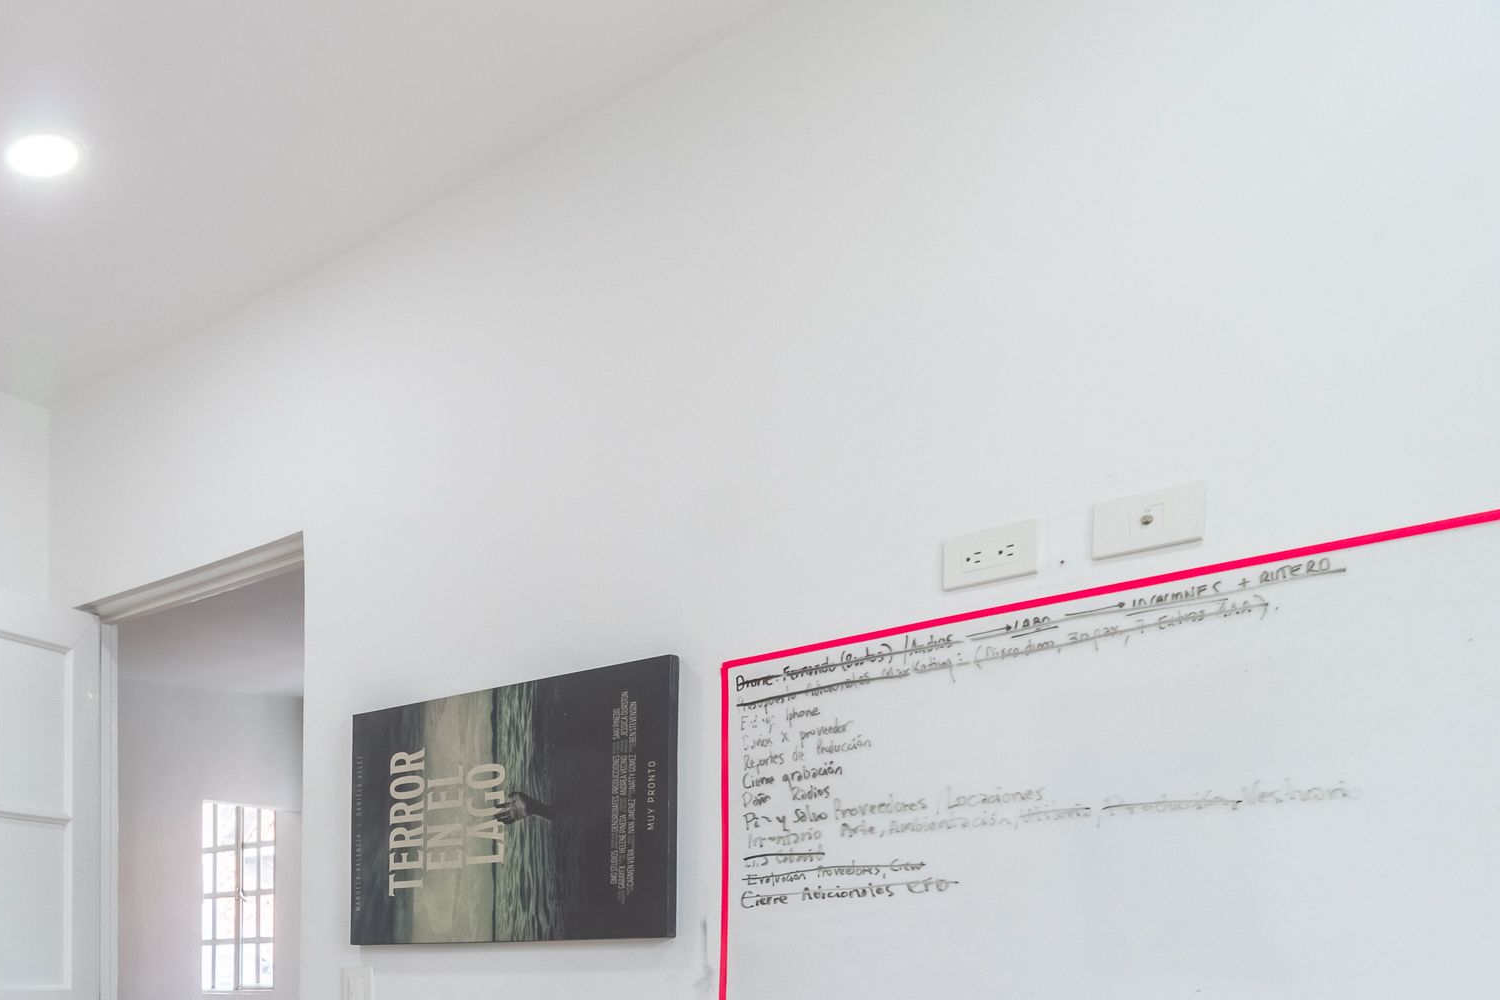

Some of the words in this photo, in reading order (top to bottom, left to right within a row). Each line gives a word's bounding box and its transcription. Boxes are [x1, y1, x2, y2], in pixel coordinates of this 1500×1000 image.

[1258, 557, 1330, 585] RUTERO
[743, 749, 785, 775] Reportes
[791, 745, 805, 762] de
[426, 764, 464, 812] EL
[647, 760, 656, 803] PRONTO
[781, 761, 843, 790] grabación
[388, 747, 425, 897] TERROR
[465, 763, 506, 866] LAGO
[647, 808, 655, 831] MUY
[776, 815, 790, 832] y
[426, 822, 463, 872] EN
[740, 890, 789, 909] Cierre
[801, 881, 895, 901] Adicionales
